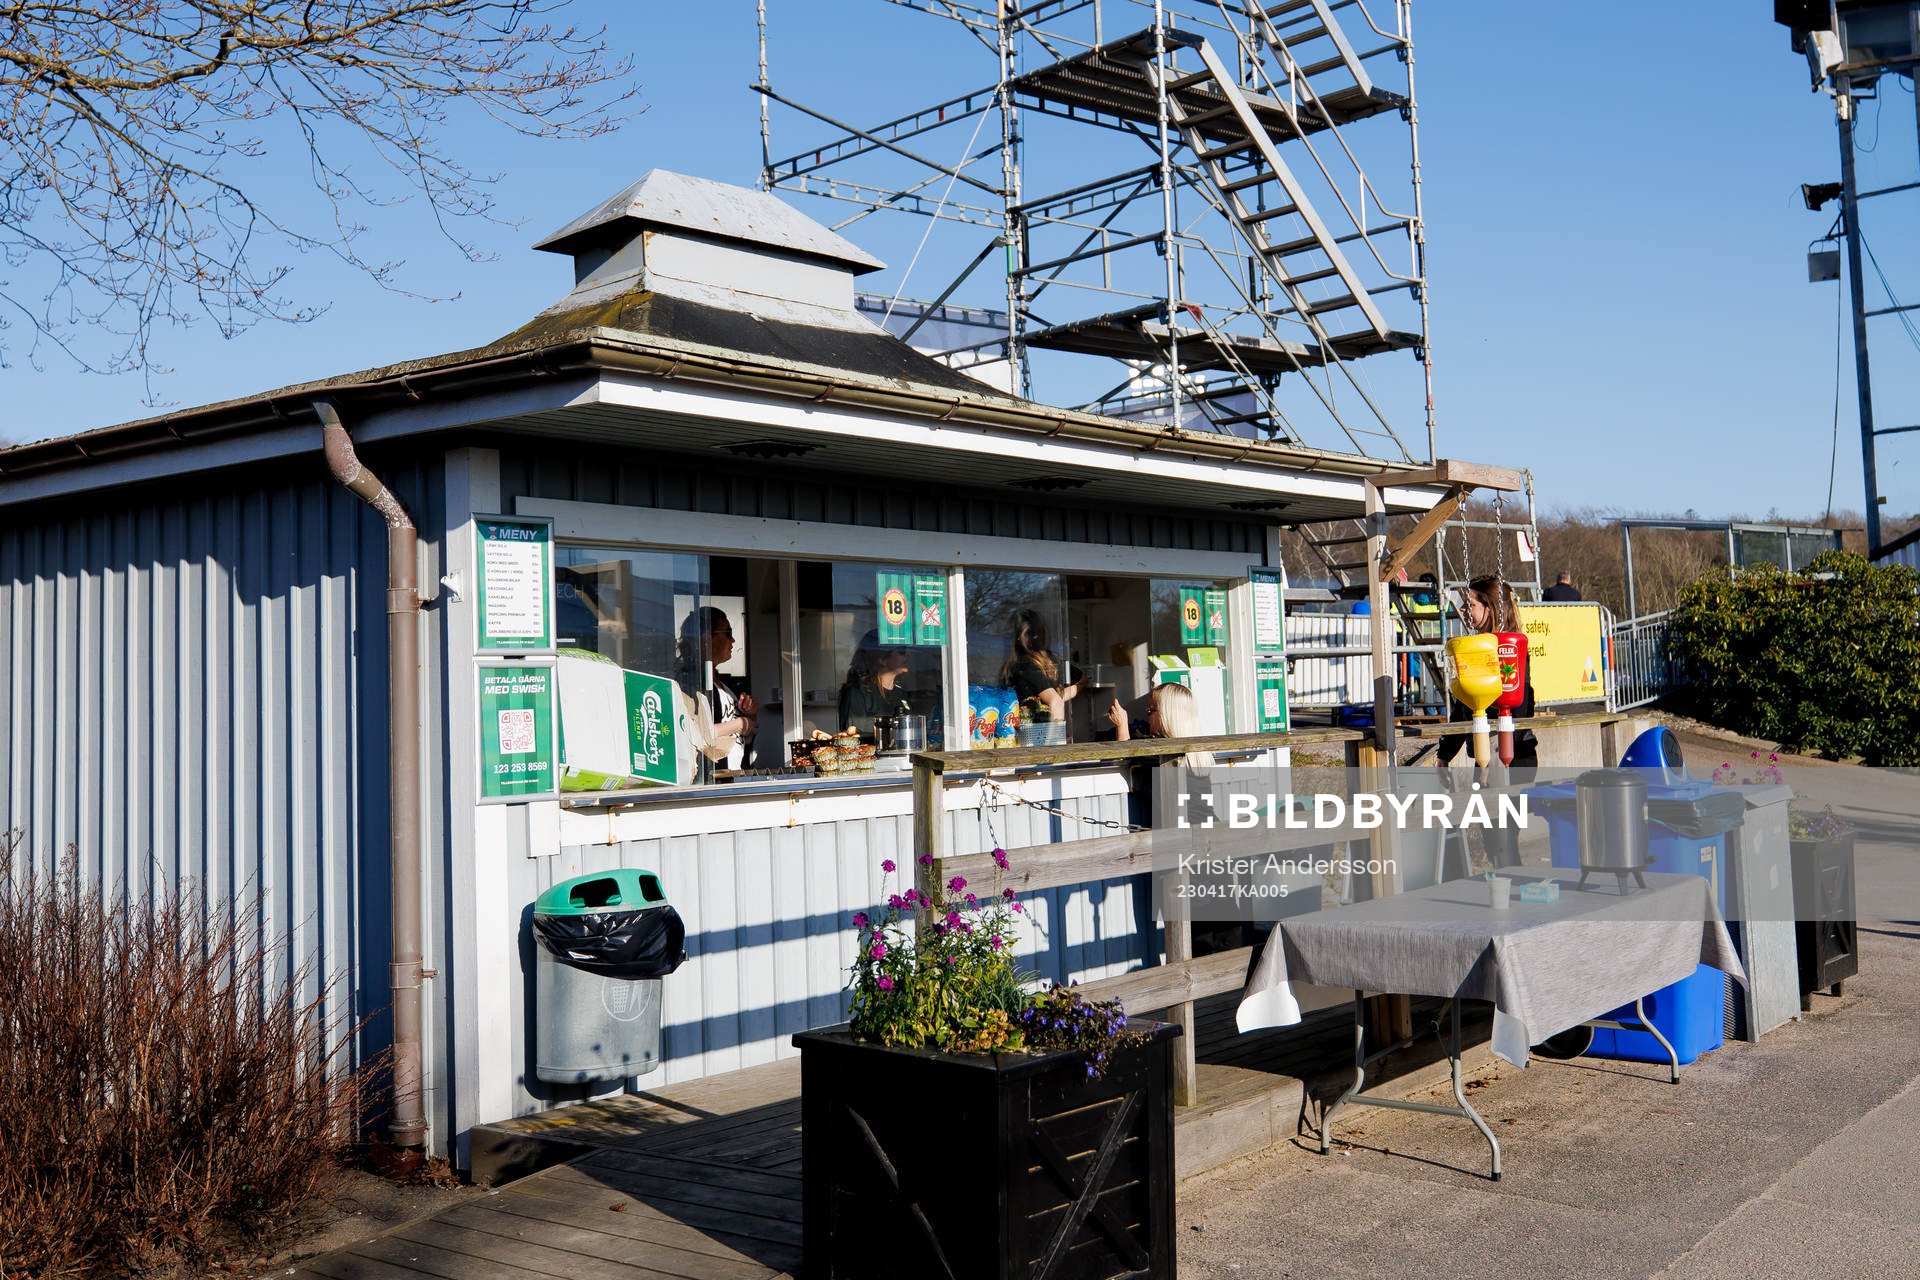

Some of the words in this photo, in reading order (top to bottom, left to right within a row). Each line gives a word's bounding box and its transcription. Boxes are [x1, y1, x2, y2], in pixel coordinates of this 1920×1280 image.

[499, 528, 538, 540] MENY
[1260, 575, 1276, 583] MENY
[887, 599, 903, 615] 18
[1186, 607, 1198, 621] 18
[1525, 619, 1551, 636] safety.
[1498, 647, 1515, 655] FELIX
[485, 676, 517, 684] BETALA
[485, 685, 510, 695] MED
[511, 683, 546, 694] SWISH
[633, 708, 642, 741] PILSNER
[642, 690, 665, 766] Carlsberg
[494, 763, 509, 774] 123
[511, 762, 526, 773] 253
